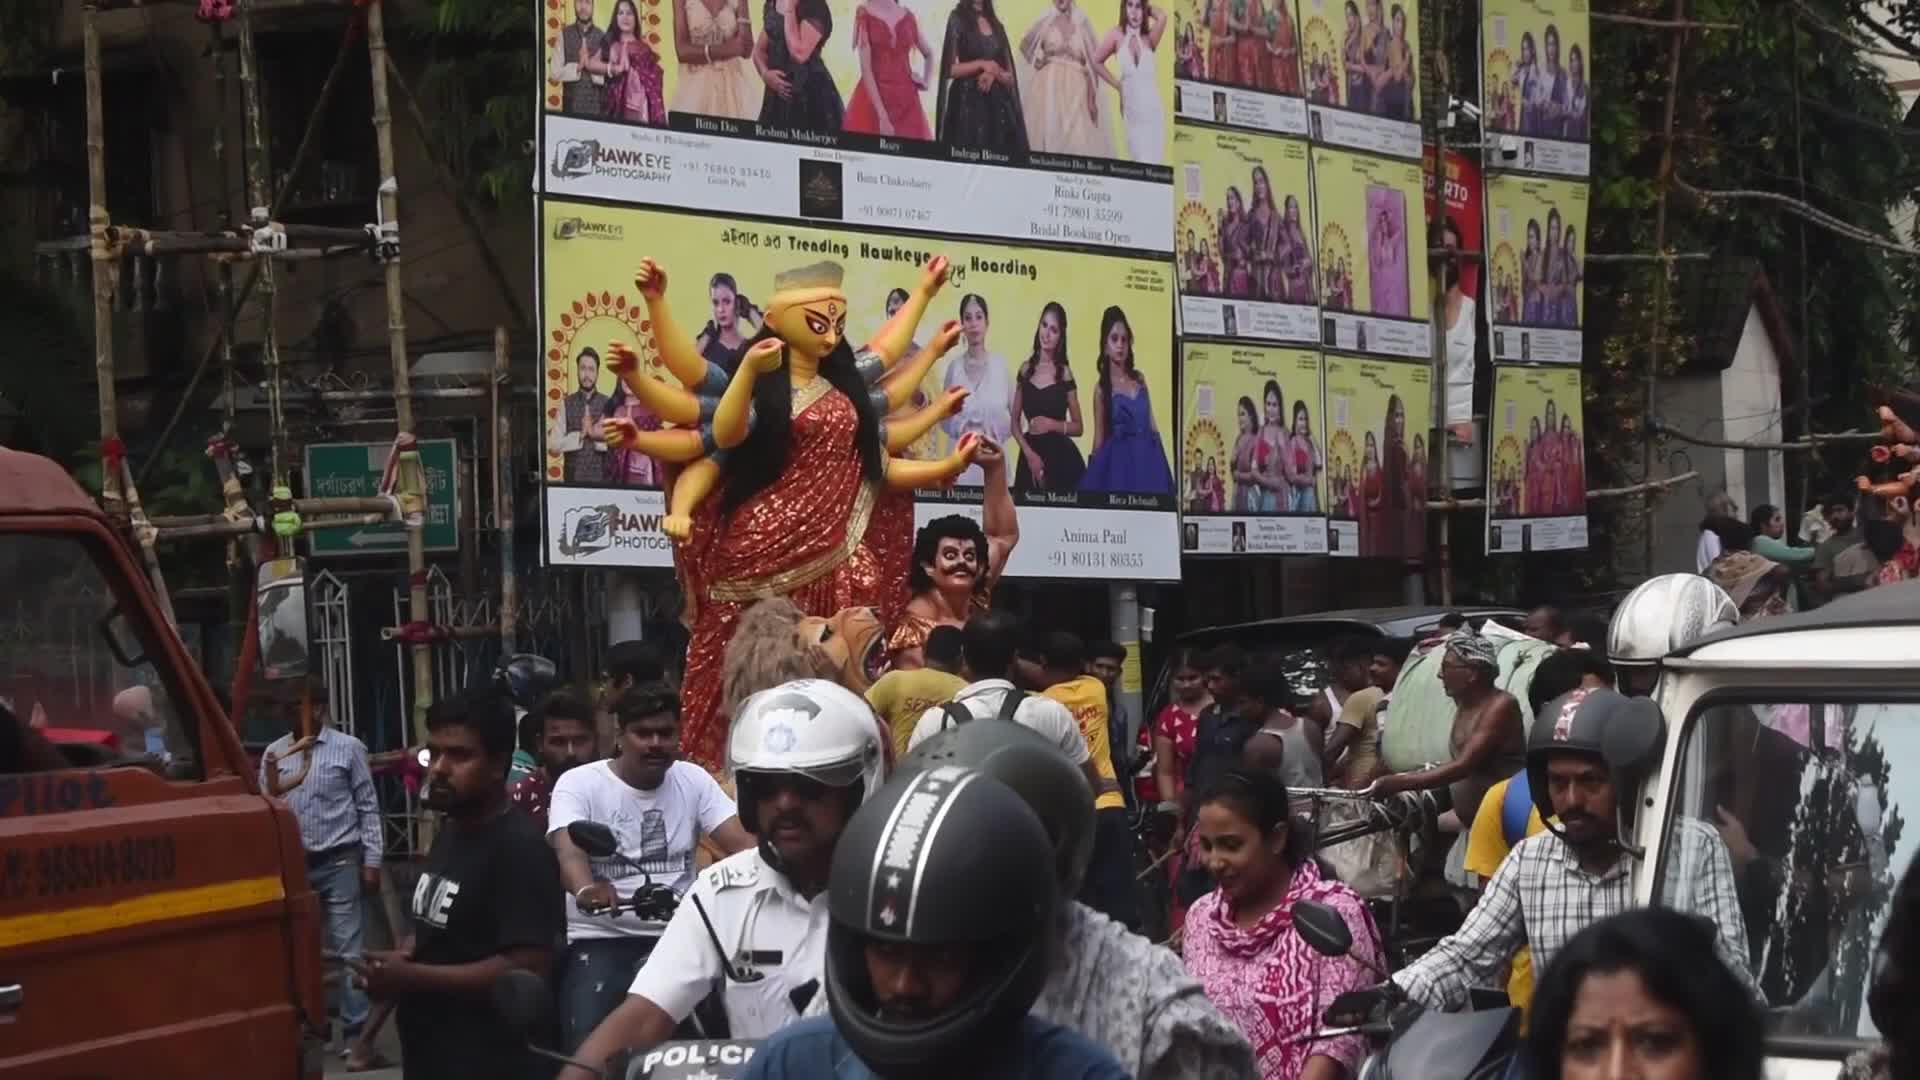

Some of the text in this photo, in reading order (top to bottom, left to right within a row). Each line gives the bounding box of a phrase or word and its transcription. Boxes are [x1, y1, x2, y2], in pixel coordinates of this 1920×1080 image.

[720, 119, 738, 133] Das
[595, 166, 672, 183] PHOTOGRAPHY
[1082, 188, 1112, 204] Gupta
[1030, 222, 1131, 245] Bridal Booking Open
[788, 236, 849, 259] Trending
[860, 243, 931, 268] Hawkeye
[970, 256, 1037, 281] Hoarding
[1061, 529, 1127, 545] Anima Paul
[1071, 552, 1106, 568] 80131
[1109, 552, 1144, 569] 80355
